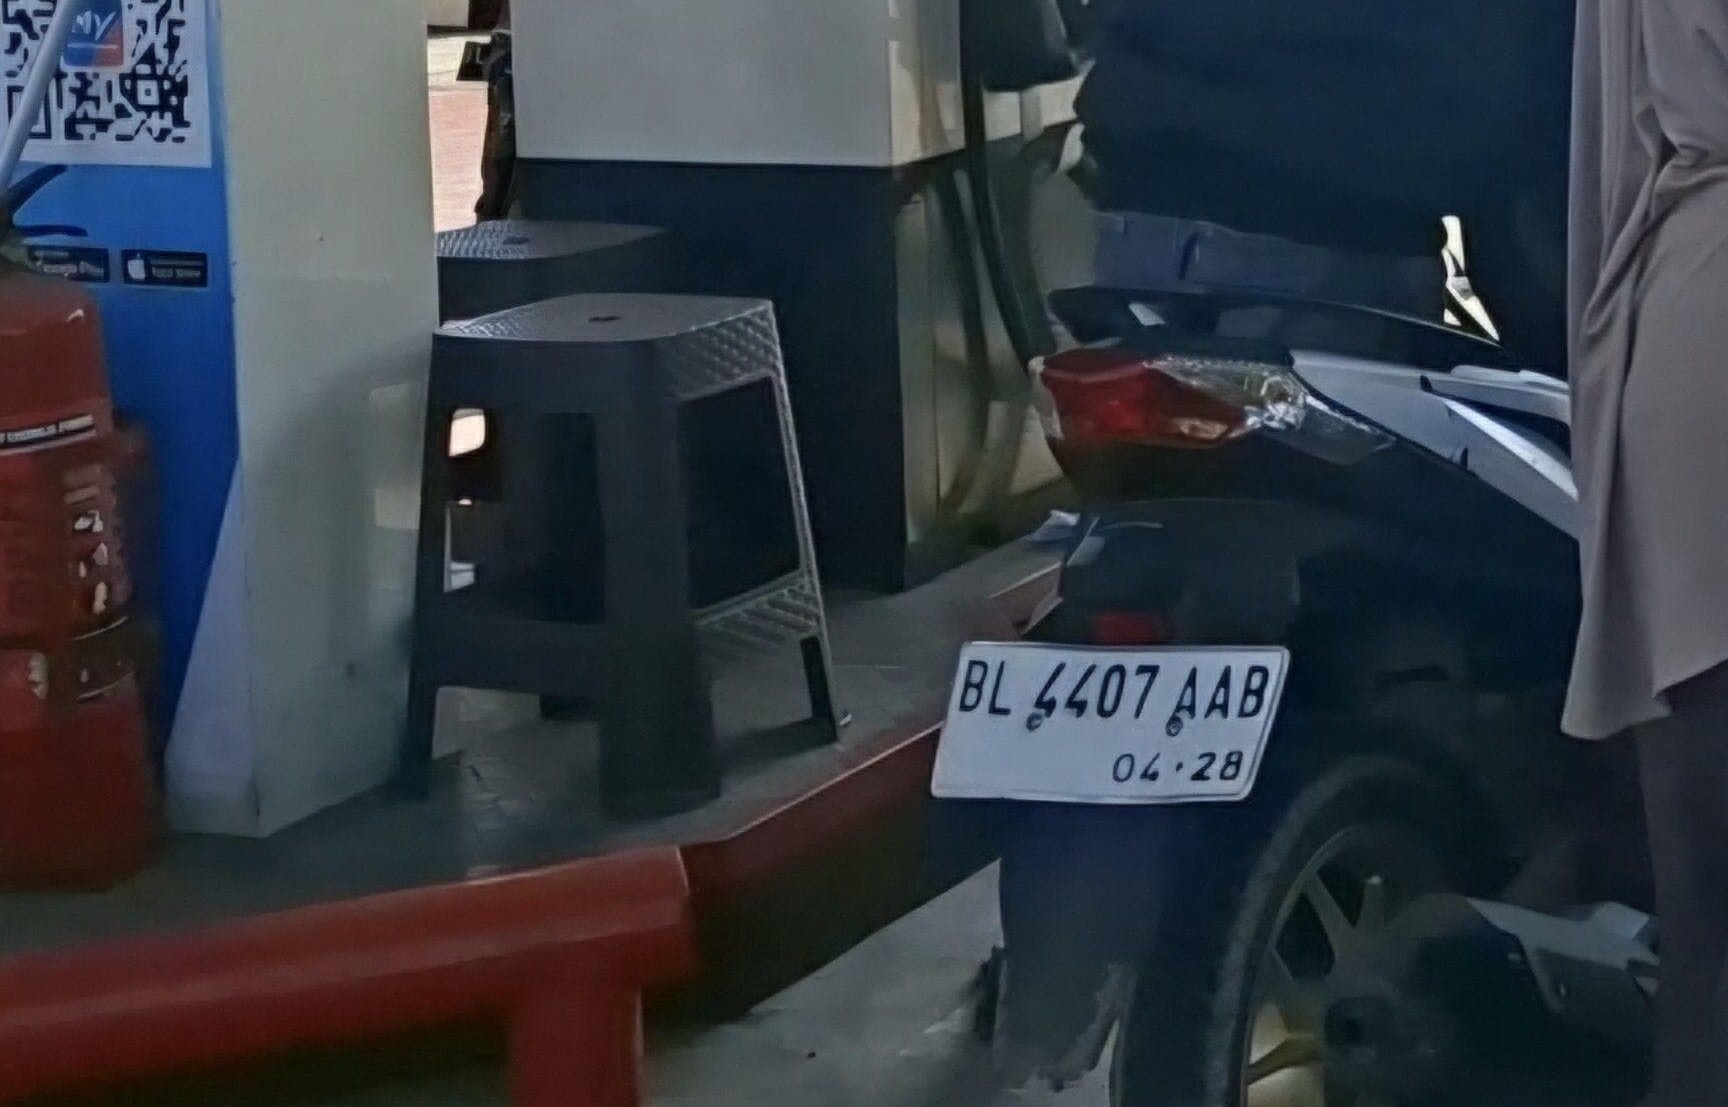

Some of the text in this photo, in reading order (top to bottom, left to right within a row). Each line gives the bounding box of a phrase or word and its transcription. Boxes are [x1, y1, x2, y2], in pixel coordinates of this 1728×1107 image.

[957, 659, 1270, 719] BL 4407 AAB
